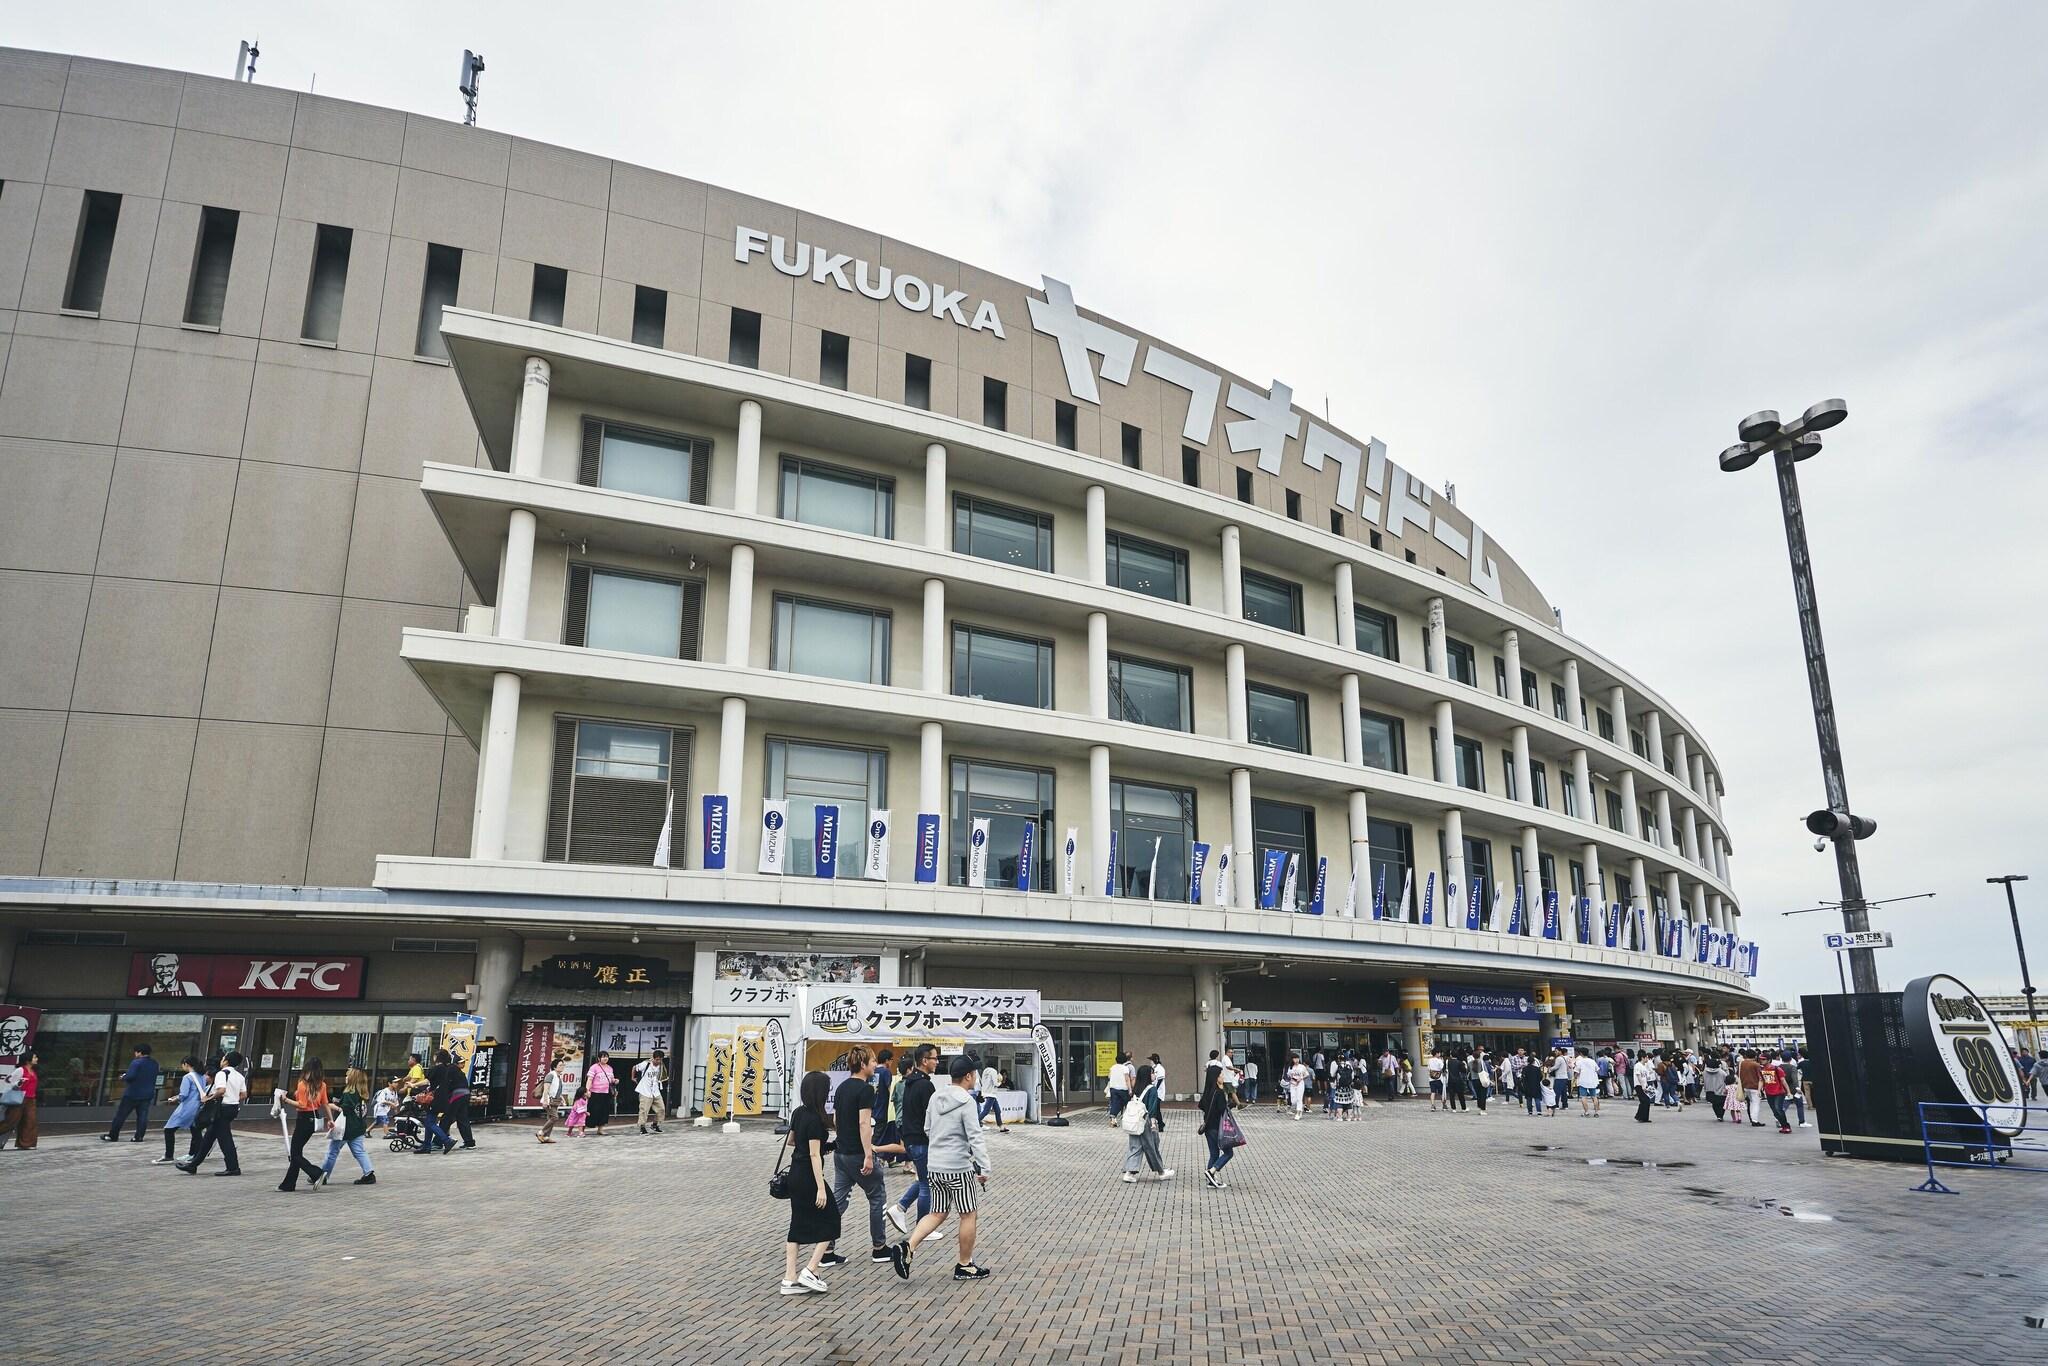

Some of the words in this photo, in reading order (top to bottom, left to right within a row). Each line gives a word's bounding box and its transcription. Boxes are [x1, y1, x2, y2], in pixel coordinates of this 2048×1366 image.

[735, 226, 1006, 339] FUKUOKA
[711, 804, 723, 855] MIZUHO
[769, 811, 779, 830] One
[873, 822, 882, 840] One
[768, 830, 778, 863] MIZUHO
[820, 815, 834, 864] MIZUHO
[923, 822, 935, 869] MIZUHO
[974, 829, 983, 846] One
[871, 839, 881, 871] MIZUHO
[971, 846, 981, 877] MIZUHO
[1021, 832, 1031, 877] MIZUHO
[1314, 863, 1326, 903] MIZUHO
[1470, 885, 1479, 919] MIZUHO
[1546, 897, 1556, 929] MIZUHO
[1855, 932, 1883, 941] 地下鉄
[239, 961, 346, 991] KFC
[594, 965, 650, 984] 鷹正
[813, 1001, 836, 1015] CLUB
[876, 994, 926, 1007] ホークス
[932, 995, 1026, 1009] 公式ファンクラブ
[1435, 995, 1456, 1003] MIZUHO
[1536, 989, 1545, 1004] 5
[812, 1004, 858, 1023] HAWKS
[866, 1010, 1033, 1030] クラブホークス窓口
[609, 1033, 669, 1051] 鷹正
[473, 1050, 488, 1085] 鷹正
[518, 1023, 535, 1106] ランチバイキング営業中
[1953, 1036, 2014, 1104] 80
